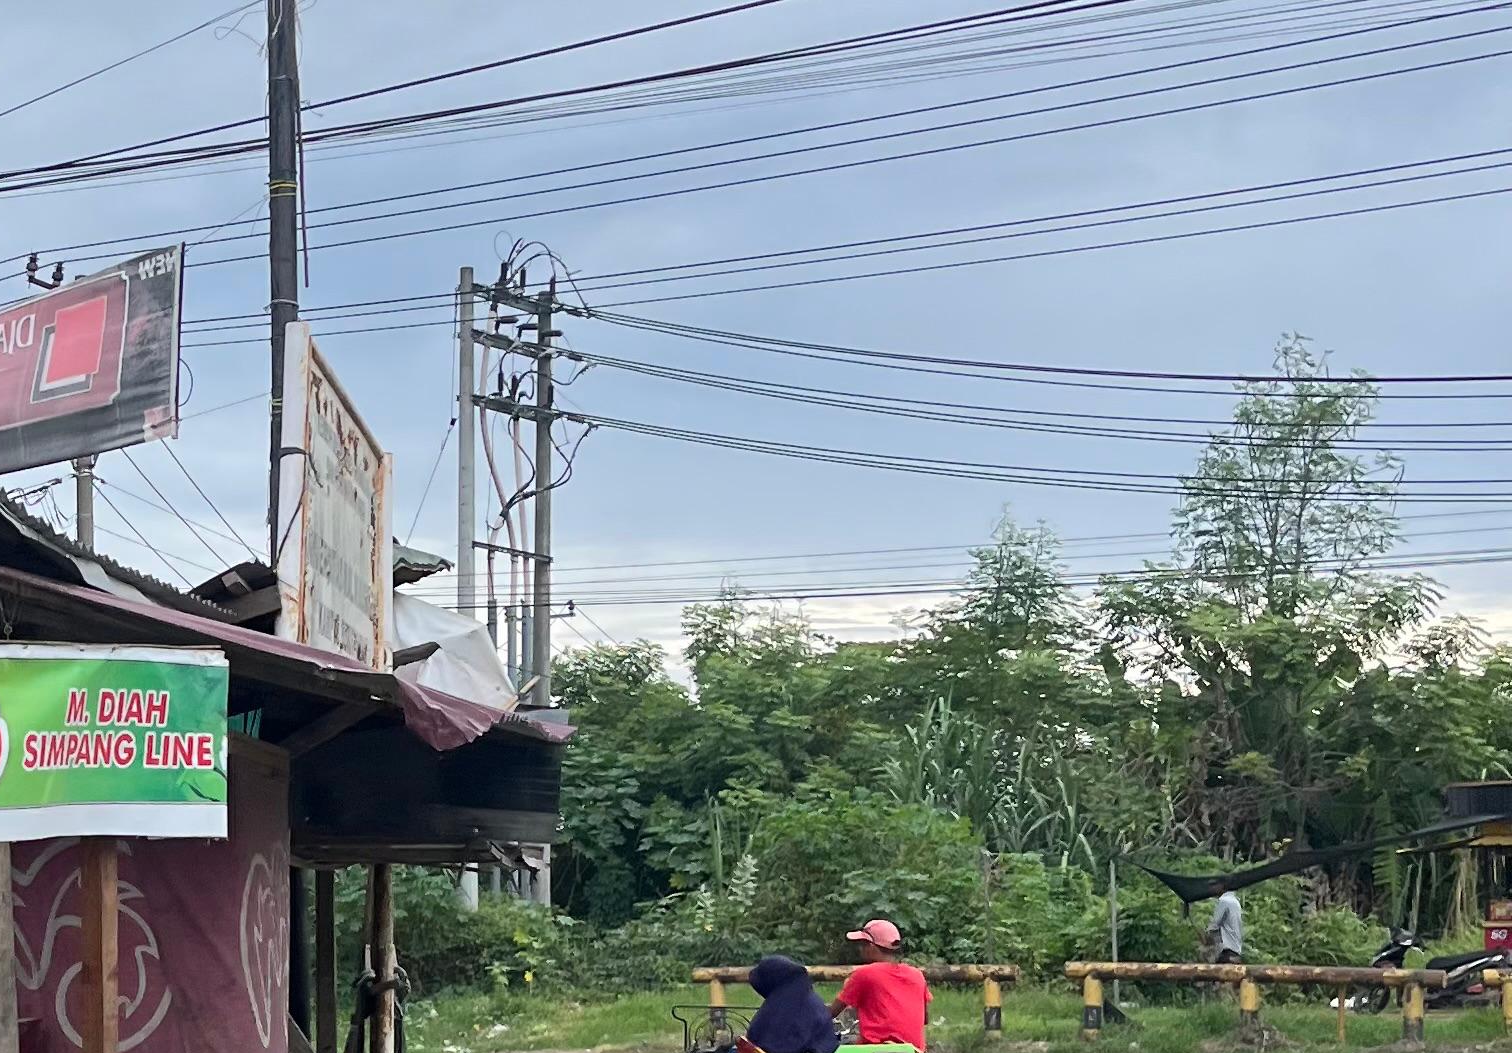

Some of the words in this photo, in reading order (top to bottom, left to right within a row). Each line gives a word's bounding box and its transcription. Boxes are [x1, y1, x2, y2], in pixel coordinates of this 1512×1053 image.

[65, 689, 90, 725] M.
[96, 689, 170, 726] DIAH
[23, 731, 137, 770] SIMPANG
[143, 732, 214, 769] LINE
